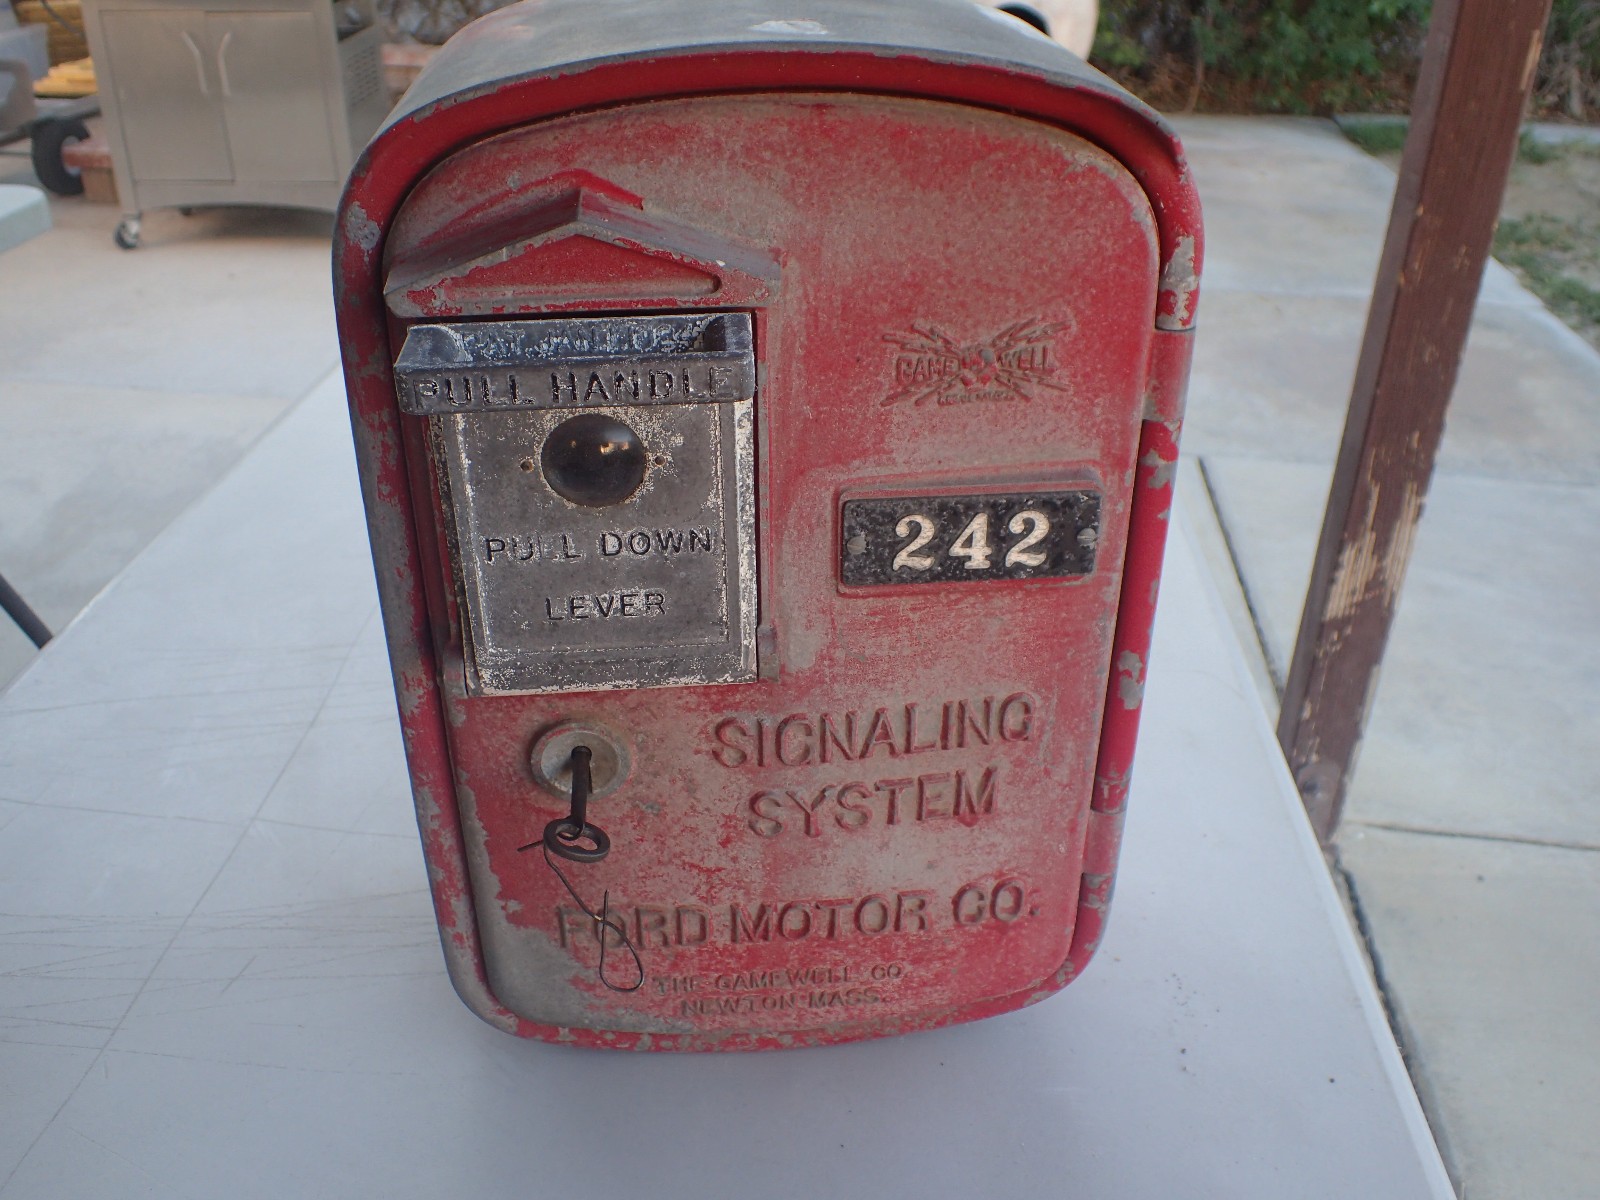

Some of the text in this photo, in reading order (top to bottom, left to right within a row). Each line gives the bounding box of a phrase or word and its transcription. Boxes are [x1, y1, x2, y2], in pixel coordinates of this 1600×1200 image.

[412, 366, 735, 409] PULL HANDLE
[485, 527, 713, 563] PULL DOWN
[892, 509, 1050, 571] 242
[544, 593, 666, 621] LEVER
[711, 691, 1038, 769] SIGNALING
[747, 764, 1000, 839] SYSTEM
[555, 879, 1041, 950] FORD MOTOR CO.
[653, 974, 701, 995] THE
[681, 991, 798, 1018] NEWTON
